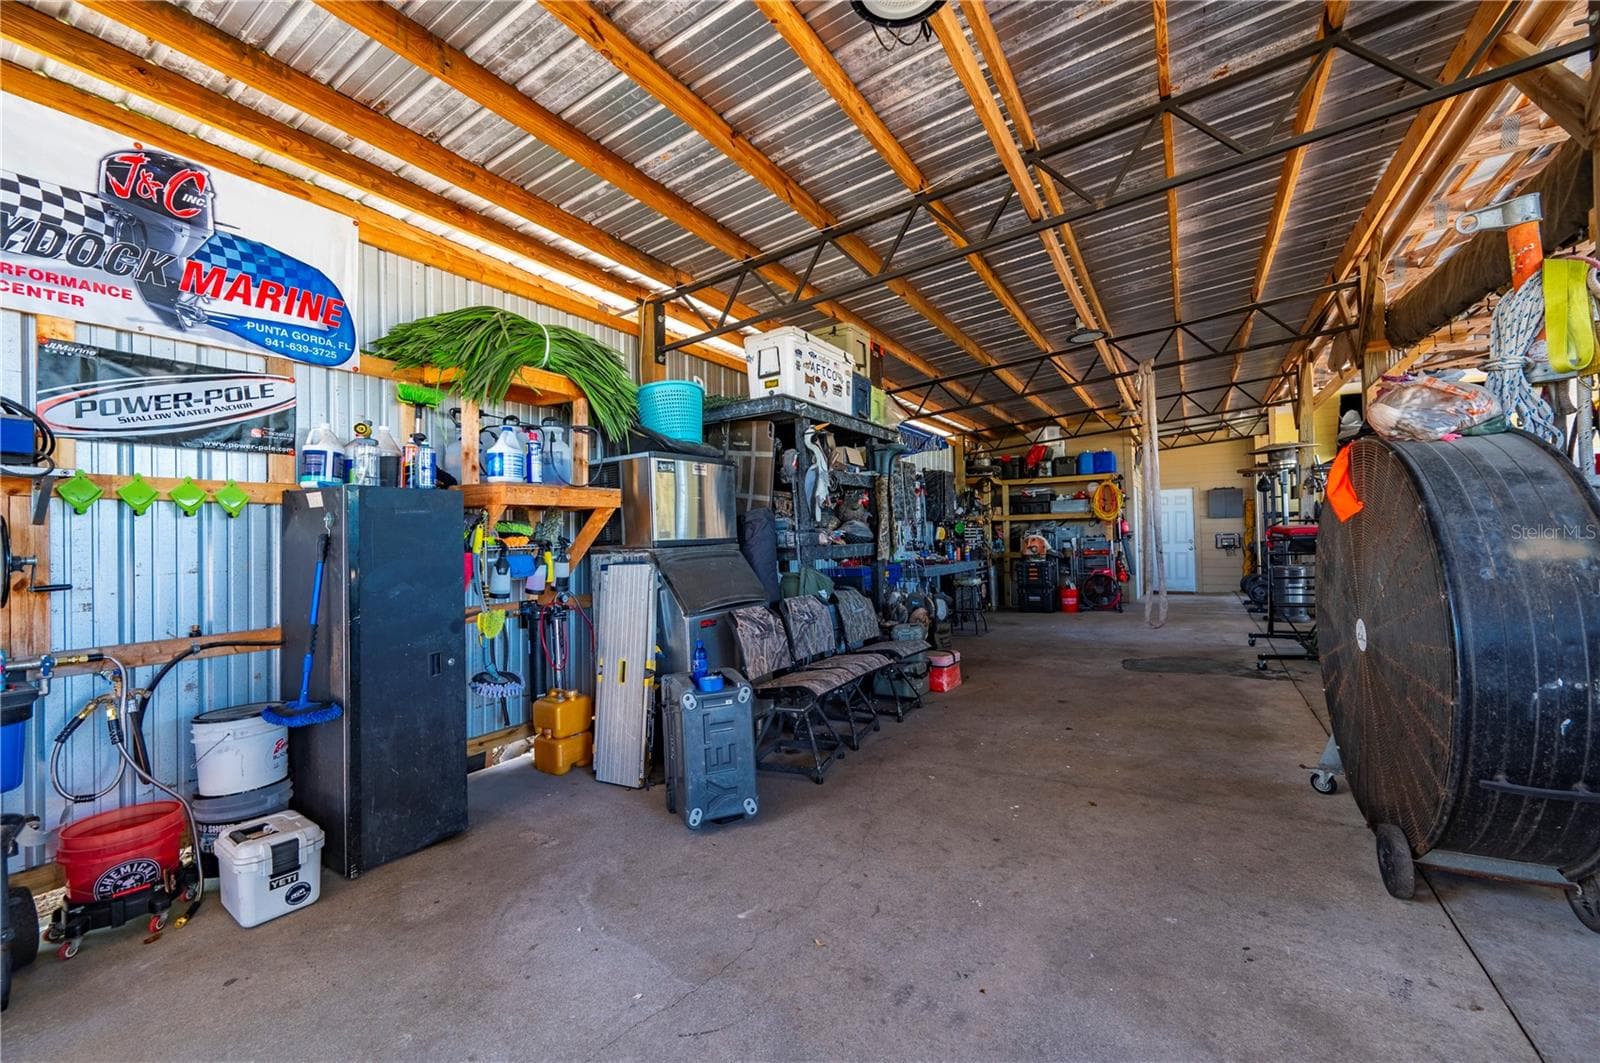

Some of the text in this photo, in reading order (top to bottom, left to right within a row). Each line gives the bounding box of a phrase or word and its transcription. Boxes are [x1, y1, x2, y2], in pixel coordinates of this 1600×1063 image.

[106, 153, 207, 218] J&C
[182, 193, 207, 208] INC.
[0, 279, 85, 307] CENTER
[179, 259, 345, 328] MARINE
[247, 321, 352, 351] PUNTA GORDA, FL
[264, 337, 337, 359] 941-639-3725
[810, 360, 837, 381] AFTCO
[75, 382, 275, 418] POWER-POLE
[203, 441, 294, 453] www.power-pole.com
[701, 699, 738, 814] YETI
[99, 862, 156, 892] CHEMICAL
[271, 874, 297, 888] YETI
